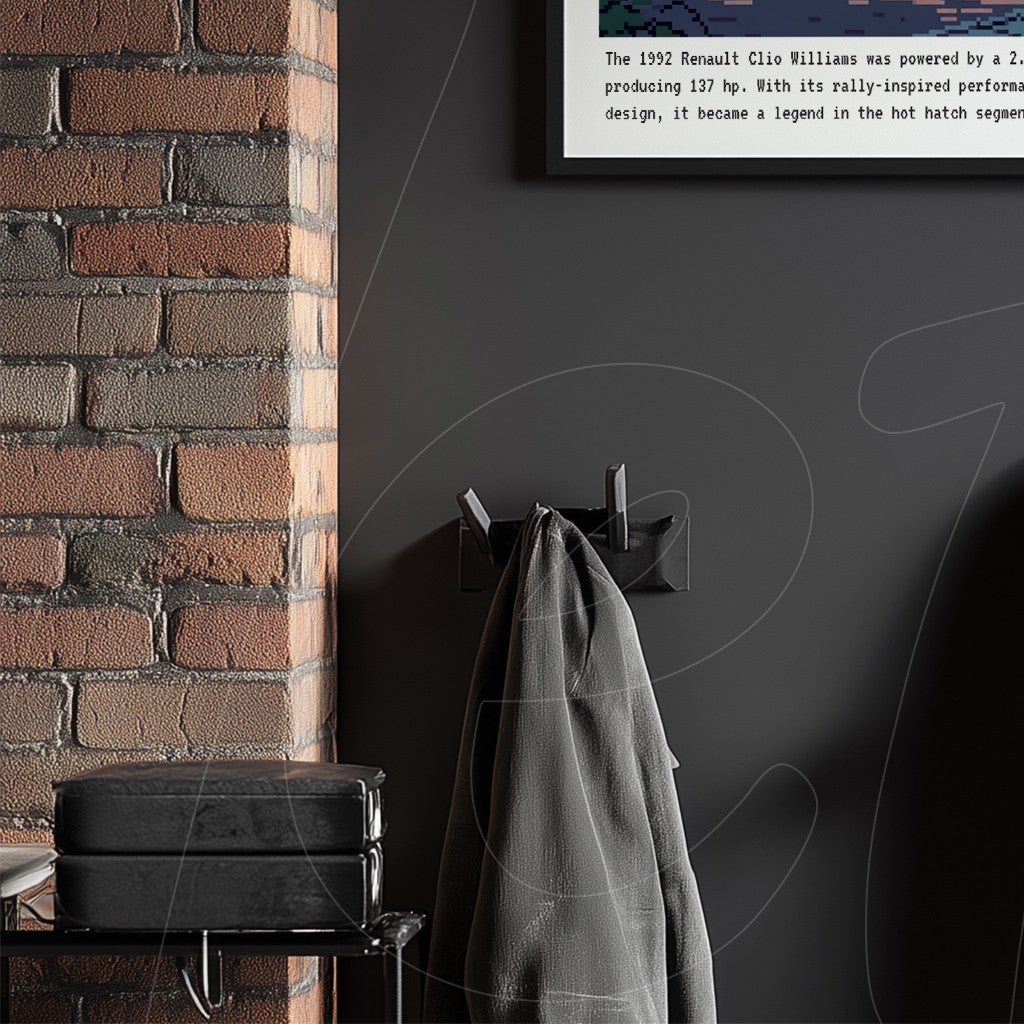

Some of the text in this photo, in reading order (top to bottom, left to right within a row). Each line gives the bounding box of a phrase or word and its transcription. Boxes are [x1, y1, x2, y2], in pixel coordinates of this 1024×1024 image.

[605, 51, 631, 66] The
[640, 51, 673, 66] 1992
[681, 51, 739, 66] Renault
[748, 51, 782, 66] Clio
[790, 51, 858, 66] Williams
[866, 54, 891, 66] was
[900, 50, 959, 69] powered
[967, 50, 984, 69] by
[992, 54, 1001, 66] a
[605, 78, 681, 97] producing
[690, 78, 714, 93] 137
[723, 78, 746, 97] hp.
[756, 78, 791, 93] With
[799, 78, 824, 93] its
[832, 78, 950, 97] rally-inspired
[605, 106, 662, 124] design,
[673, 106, 689, 120] it
[697, 106, 749, 120] became
[756, 109, 766, 120] a
[774, 106, 824, 124] legend
[833, 105, 849, 120] in
[857, 106, 883, 120] the
[891, 105, 916, 120] hot
[924, 105, 967, 120] hatch
